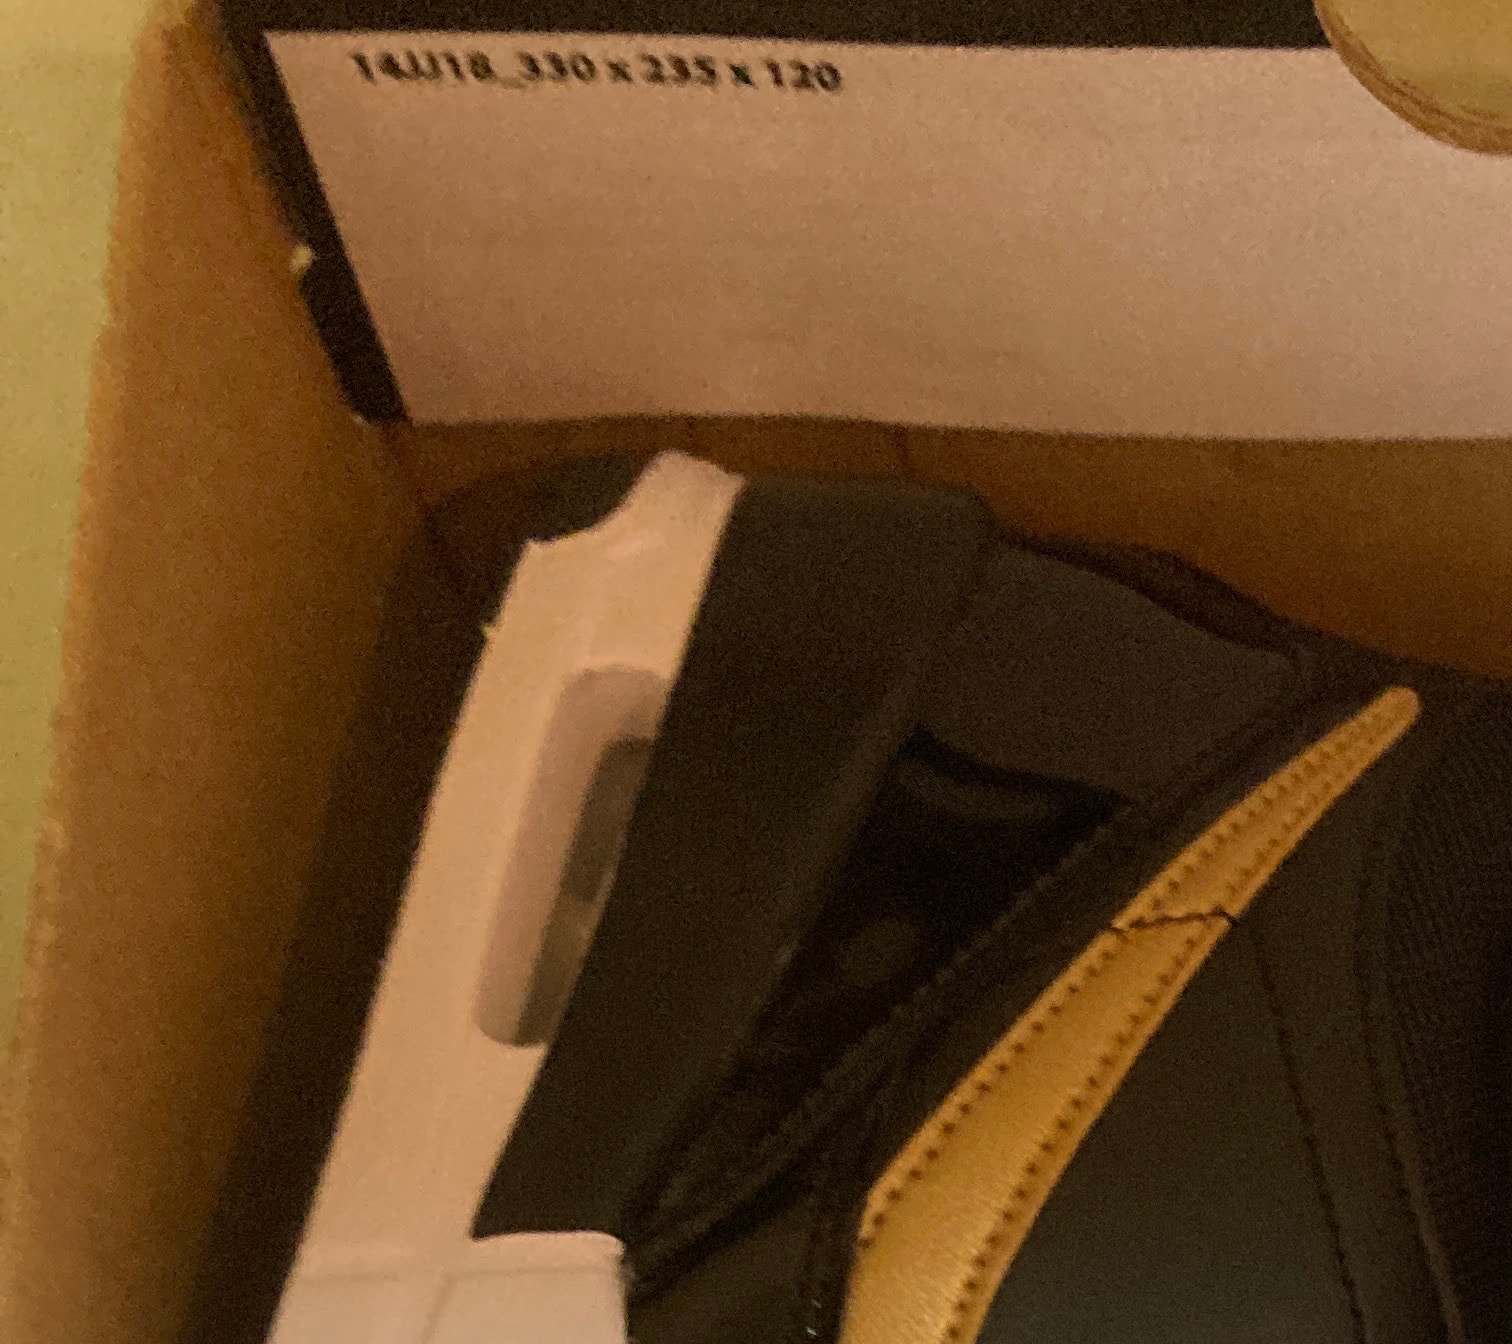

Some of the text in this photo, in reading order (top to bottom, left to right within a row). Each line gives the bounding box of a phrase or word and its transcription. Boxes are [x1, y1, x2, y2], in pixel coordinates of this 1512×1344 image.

[604, 56, 635, 84] x
[726, 62, 757, 90] x
[762, 57, 844, 93] 120
